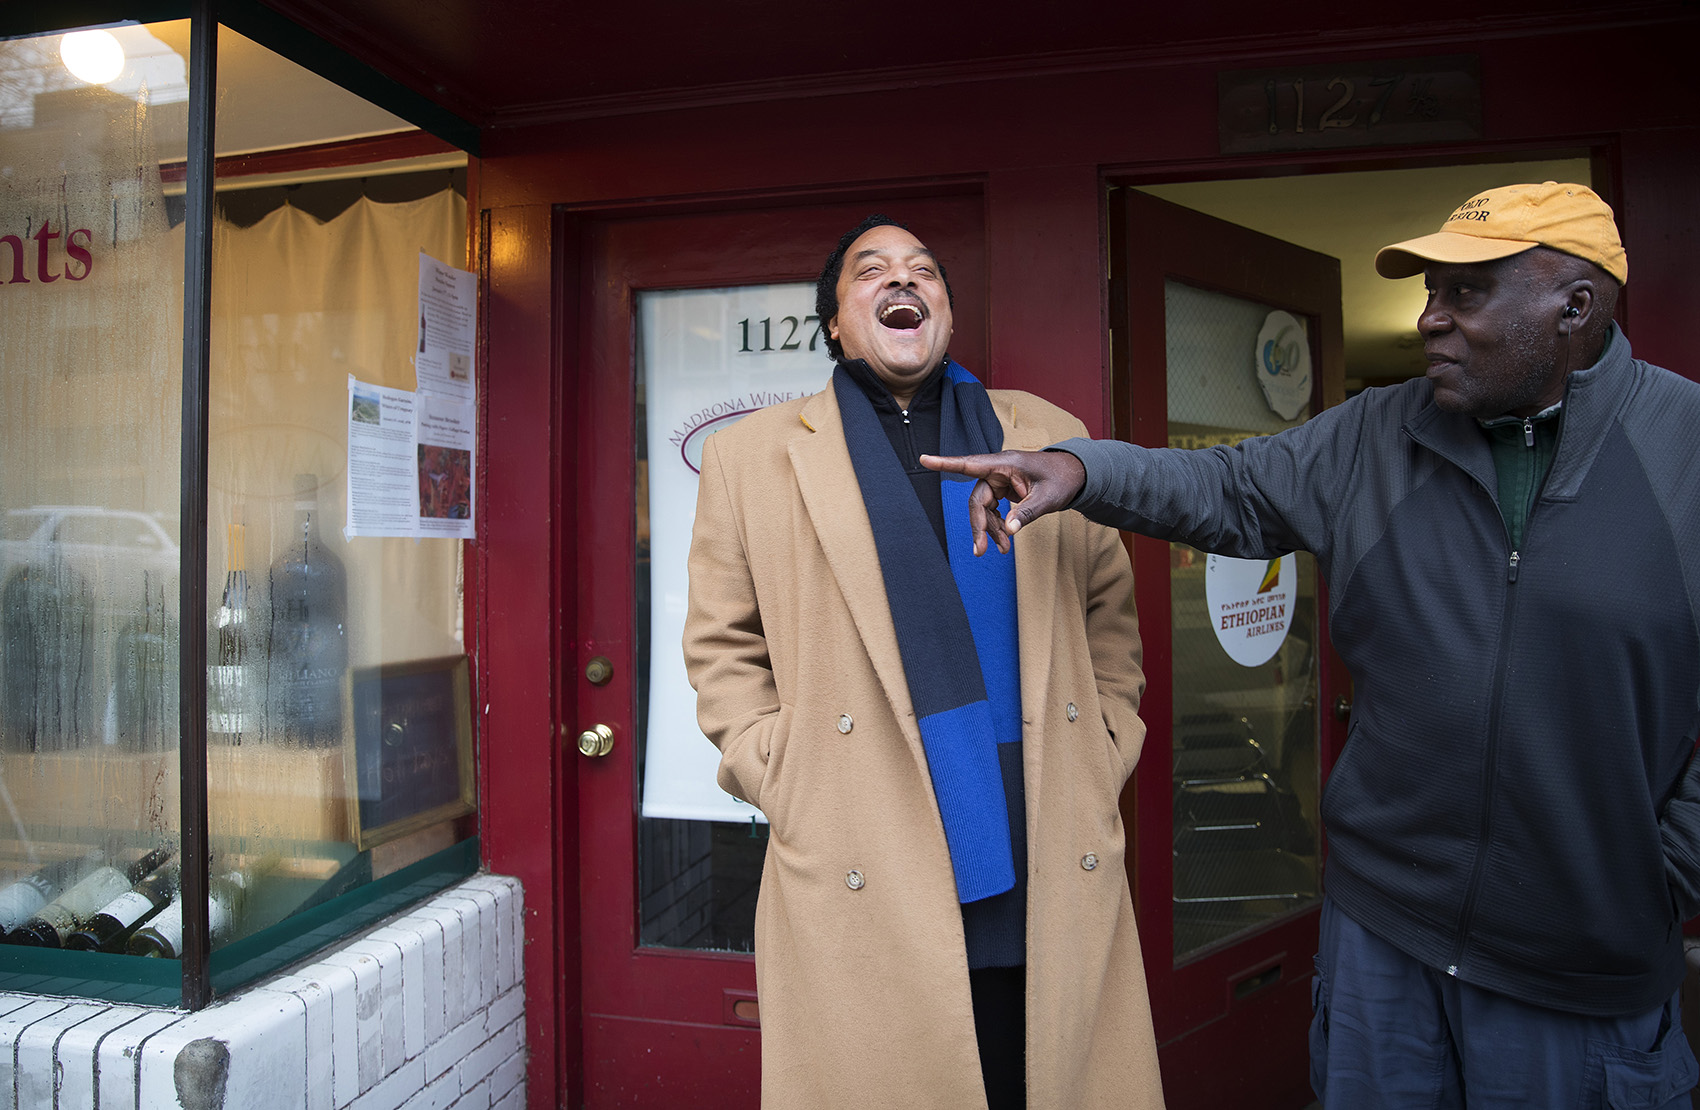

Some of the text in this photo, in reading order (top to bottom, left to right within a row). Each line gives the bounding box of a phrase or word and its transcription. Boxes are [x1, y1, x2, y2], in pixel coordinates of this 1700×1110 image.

[1264, 72, 1405, 135] 1127
[738, 315, 820, 352] 1127
[668, 397, 746, 447] MADRONA
[1221, 603, 1285, 630] ETHIOPIAN
[1246, 621, 1285, 638] AIRLINES
